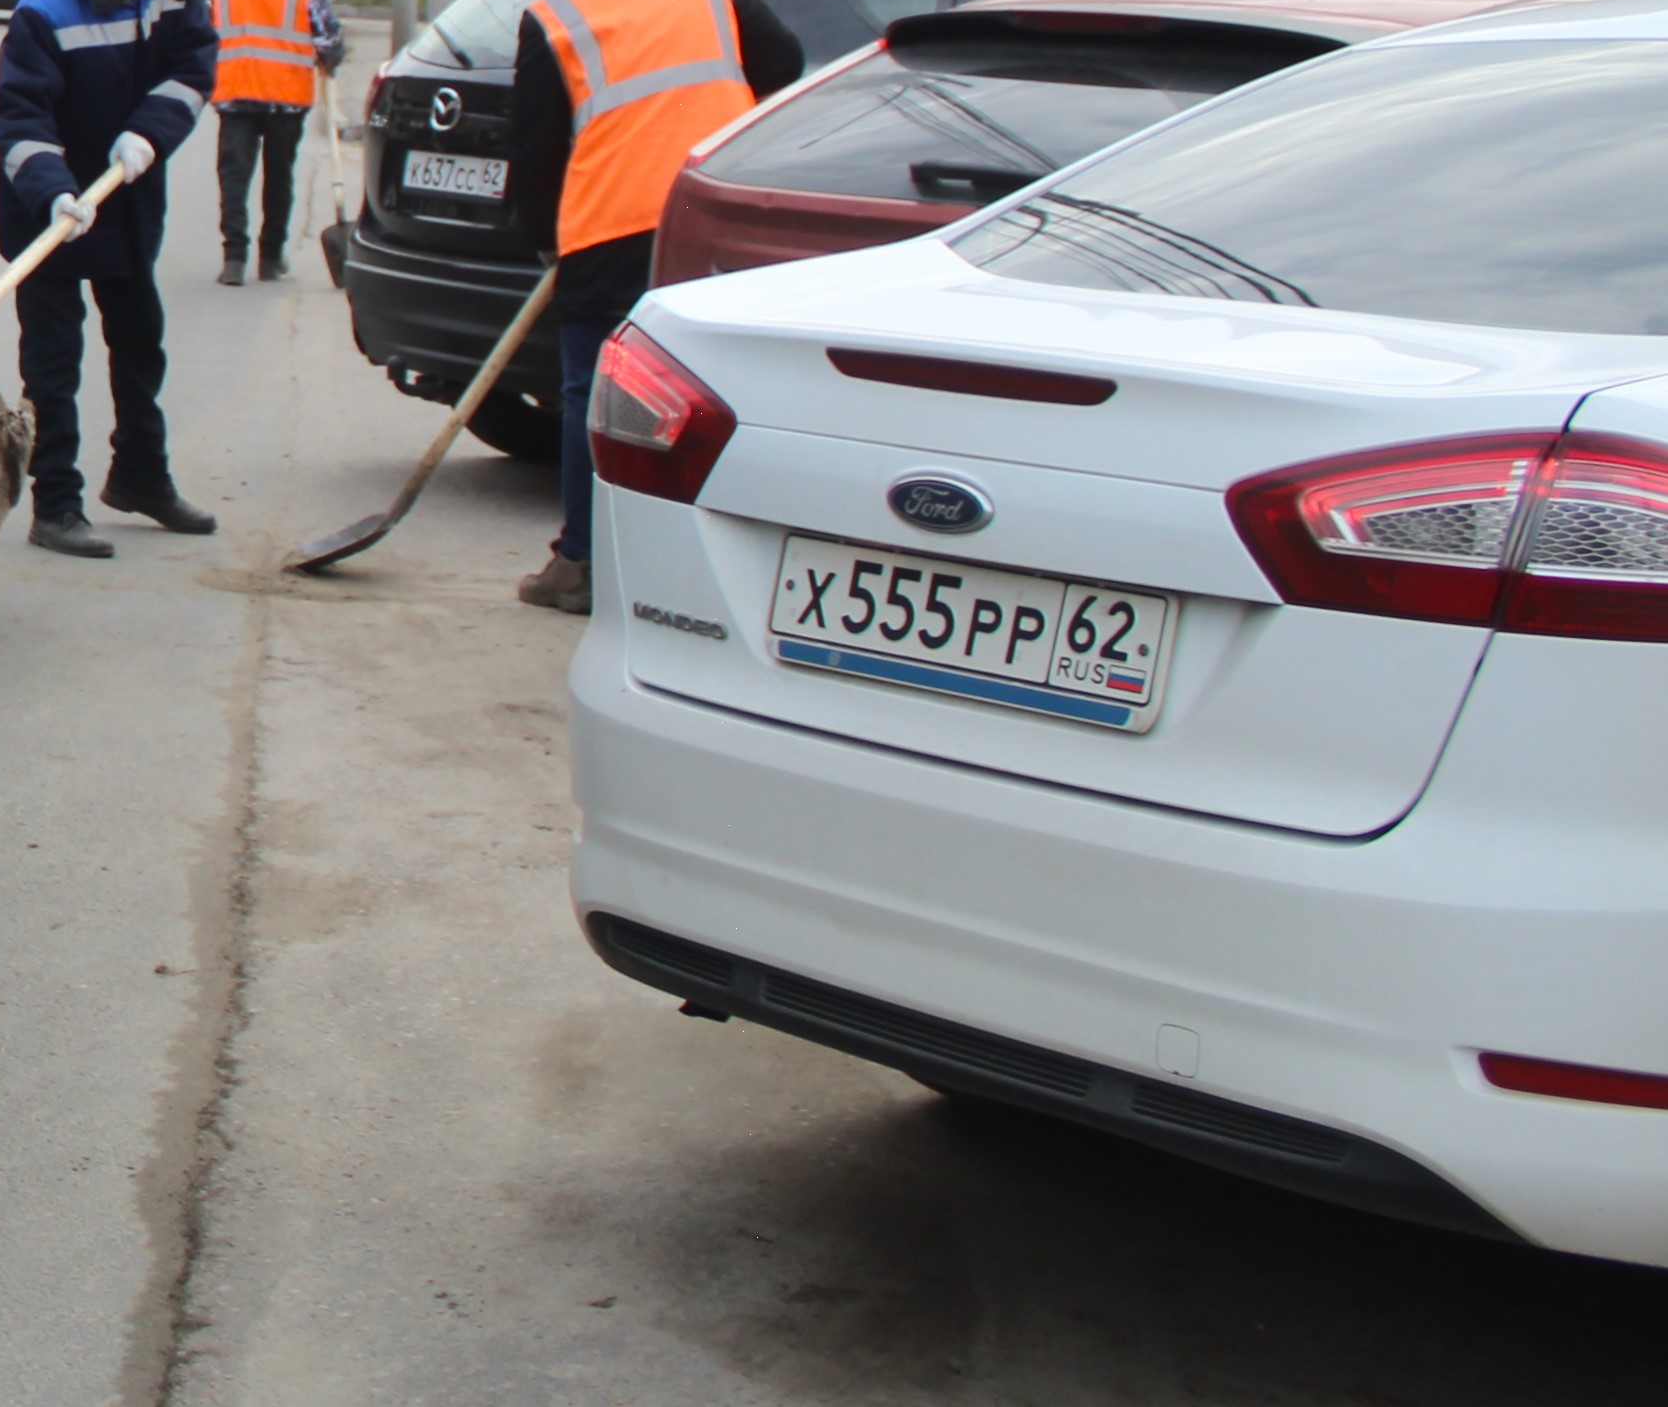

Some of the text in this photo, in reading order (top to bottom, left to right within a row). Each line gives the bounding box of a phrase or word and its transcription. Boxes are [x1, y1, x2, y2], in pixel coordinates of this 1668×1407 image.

[482, 161, 502, 185] 62
[904, 486, 963, 522] Ford
[1067, 595, 1136, 663] 62
[1055, 656, 1105, 685] RUS
